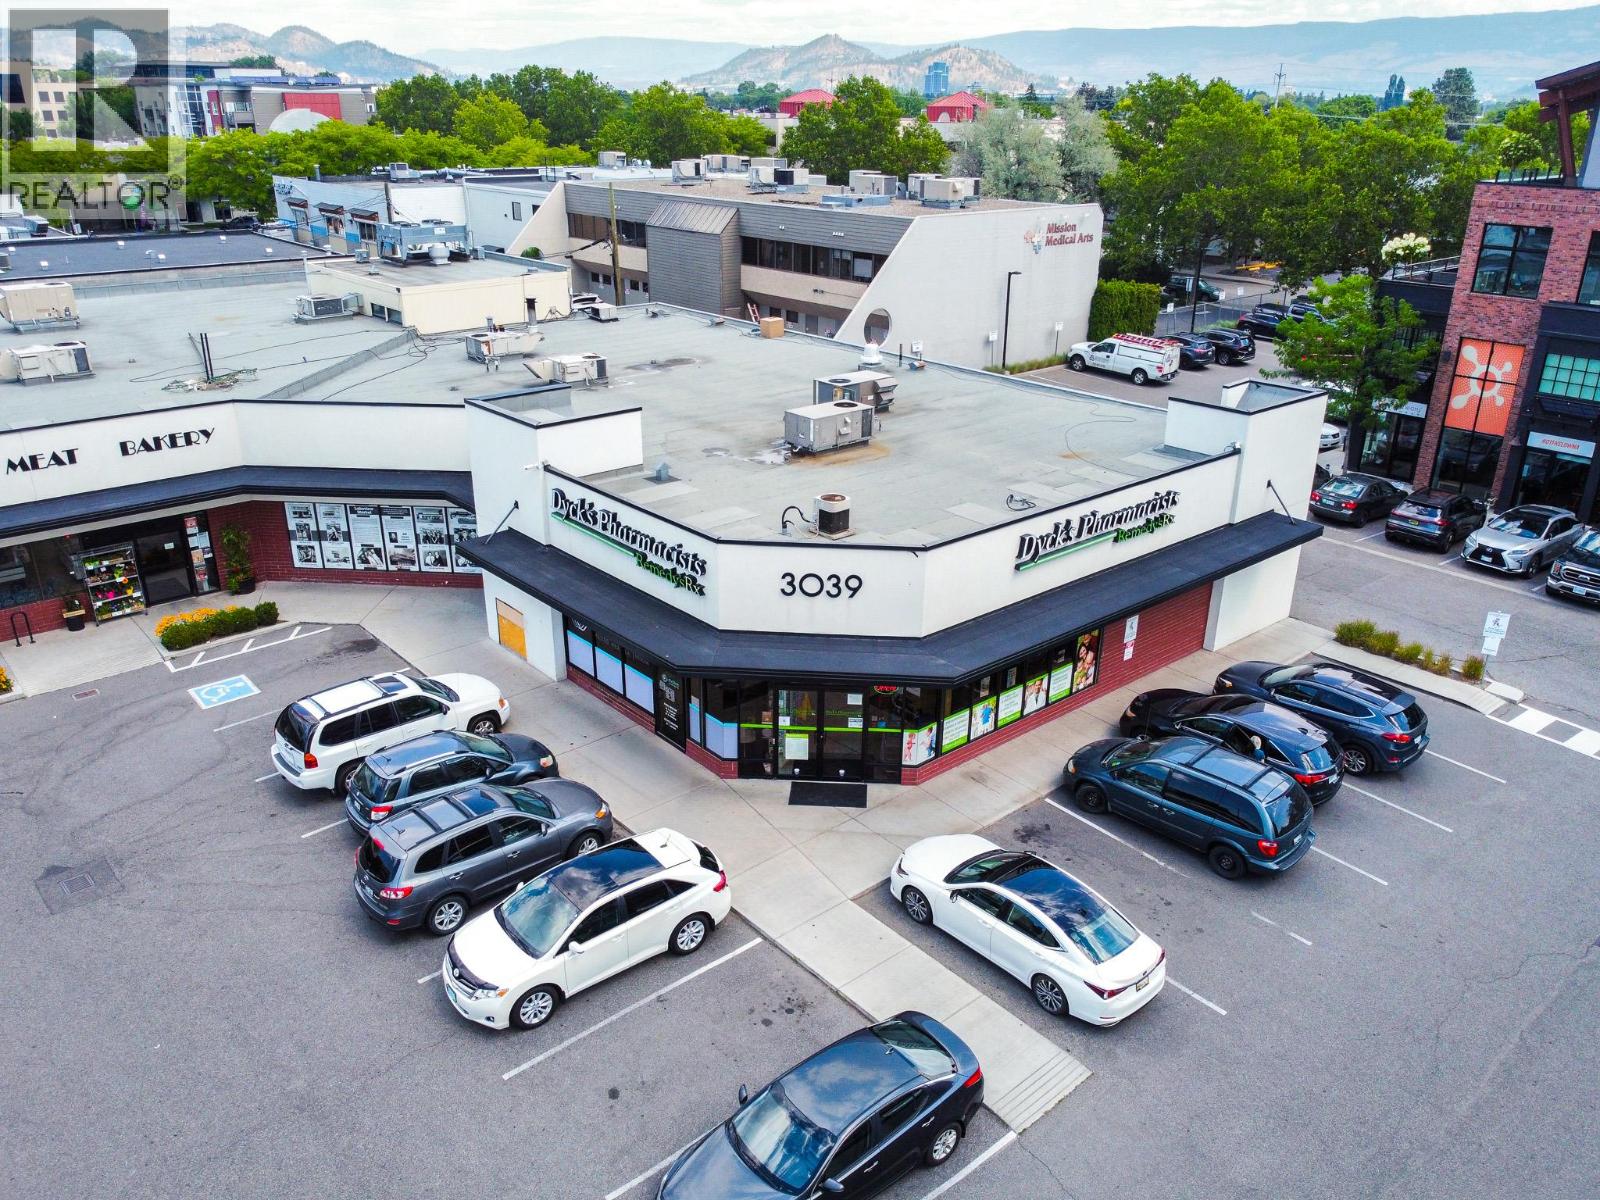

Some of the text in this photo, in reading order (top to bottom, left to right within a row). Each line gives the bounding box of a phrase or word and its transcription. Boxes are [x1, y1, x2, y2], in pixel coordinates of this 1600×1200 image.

[1045, 232, 1094, 246] Medical Arts
[1046, 222, 1077, 234] Mission
[6, 427, 215, 475] MEAT BAKERY
[551, 488, 707, 577] Dyck's Pharmacists
[1016, 490, 1181, 563] Dyck's Pharmacists
[780, 572, 863, 598] 3039
